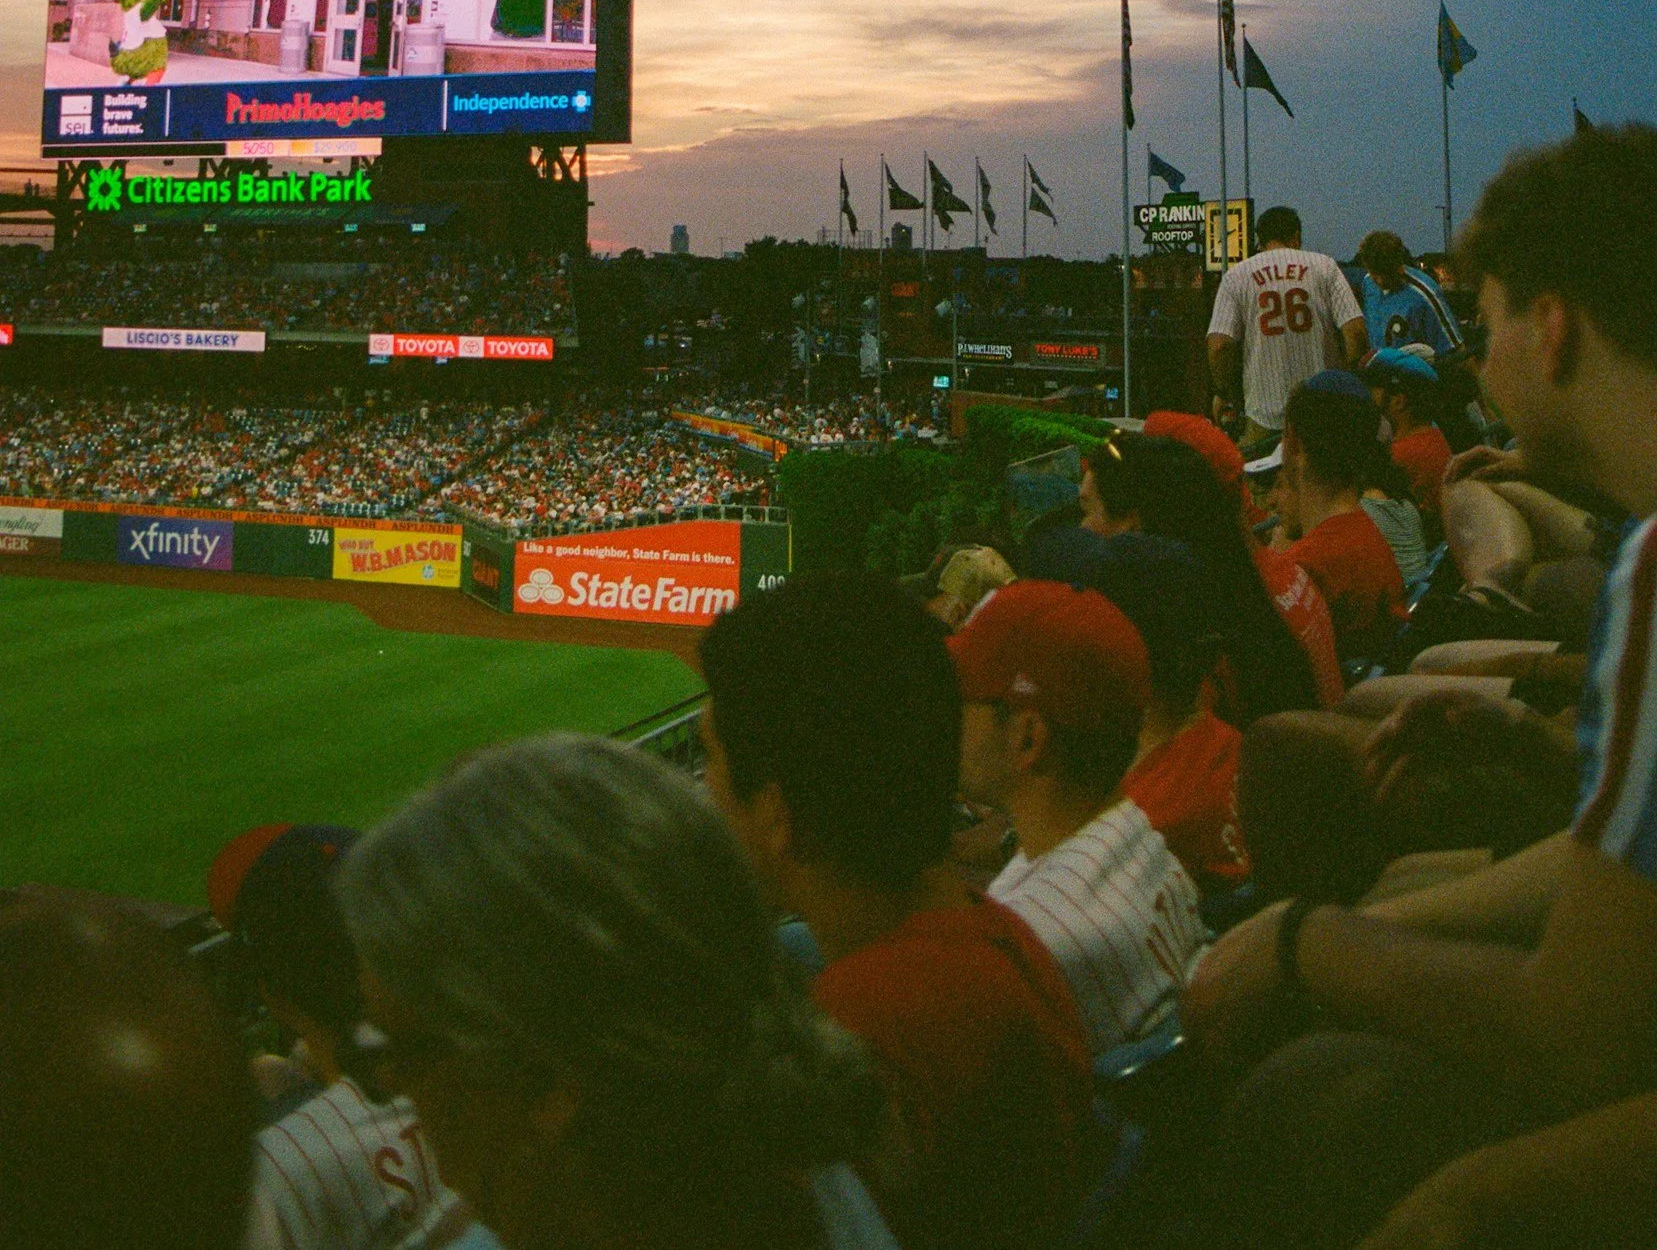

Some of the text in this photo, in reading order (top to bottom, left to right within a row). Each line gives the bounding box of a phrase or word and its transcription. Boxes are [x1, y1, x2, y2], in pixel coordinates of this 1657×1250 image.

[104, 93, 147, 109] Building
[453, 92, 569, 114] Independence
[103, 108, 133, 120] brave
[226, 92, 385, 128] PrimoHoagies
[127, 168, 373, 203] Citizens Bank Park
[1140, 207, 1157, 223] CP
[1152, 231, 1194, 242] ROOFTOP
[1251, 263, 1310, 287] UTLEY
[1258, 287, 1313, 336] 26
[126, 332, 239, 347] LISCIO'S BAKERY
[397, 338, 456, 353] TOYOTA
[488, 341, 549, 356] TOYOTA
[246, 512, 304, 524] ASPLUNDH
[315, 517, 377, 529] ASPLUNDH
[391, 522, 454, 534] ASPLUNDH
[130, 522, 220, 564] xfinity
[308, 529, 329, 545] 374
[523, 541, 735, 565] Like a good neighbor, State Farm is there.
